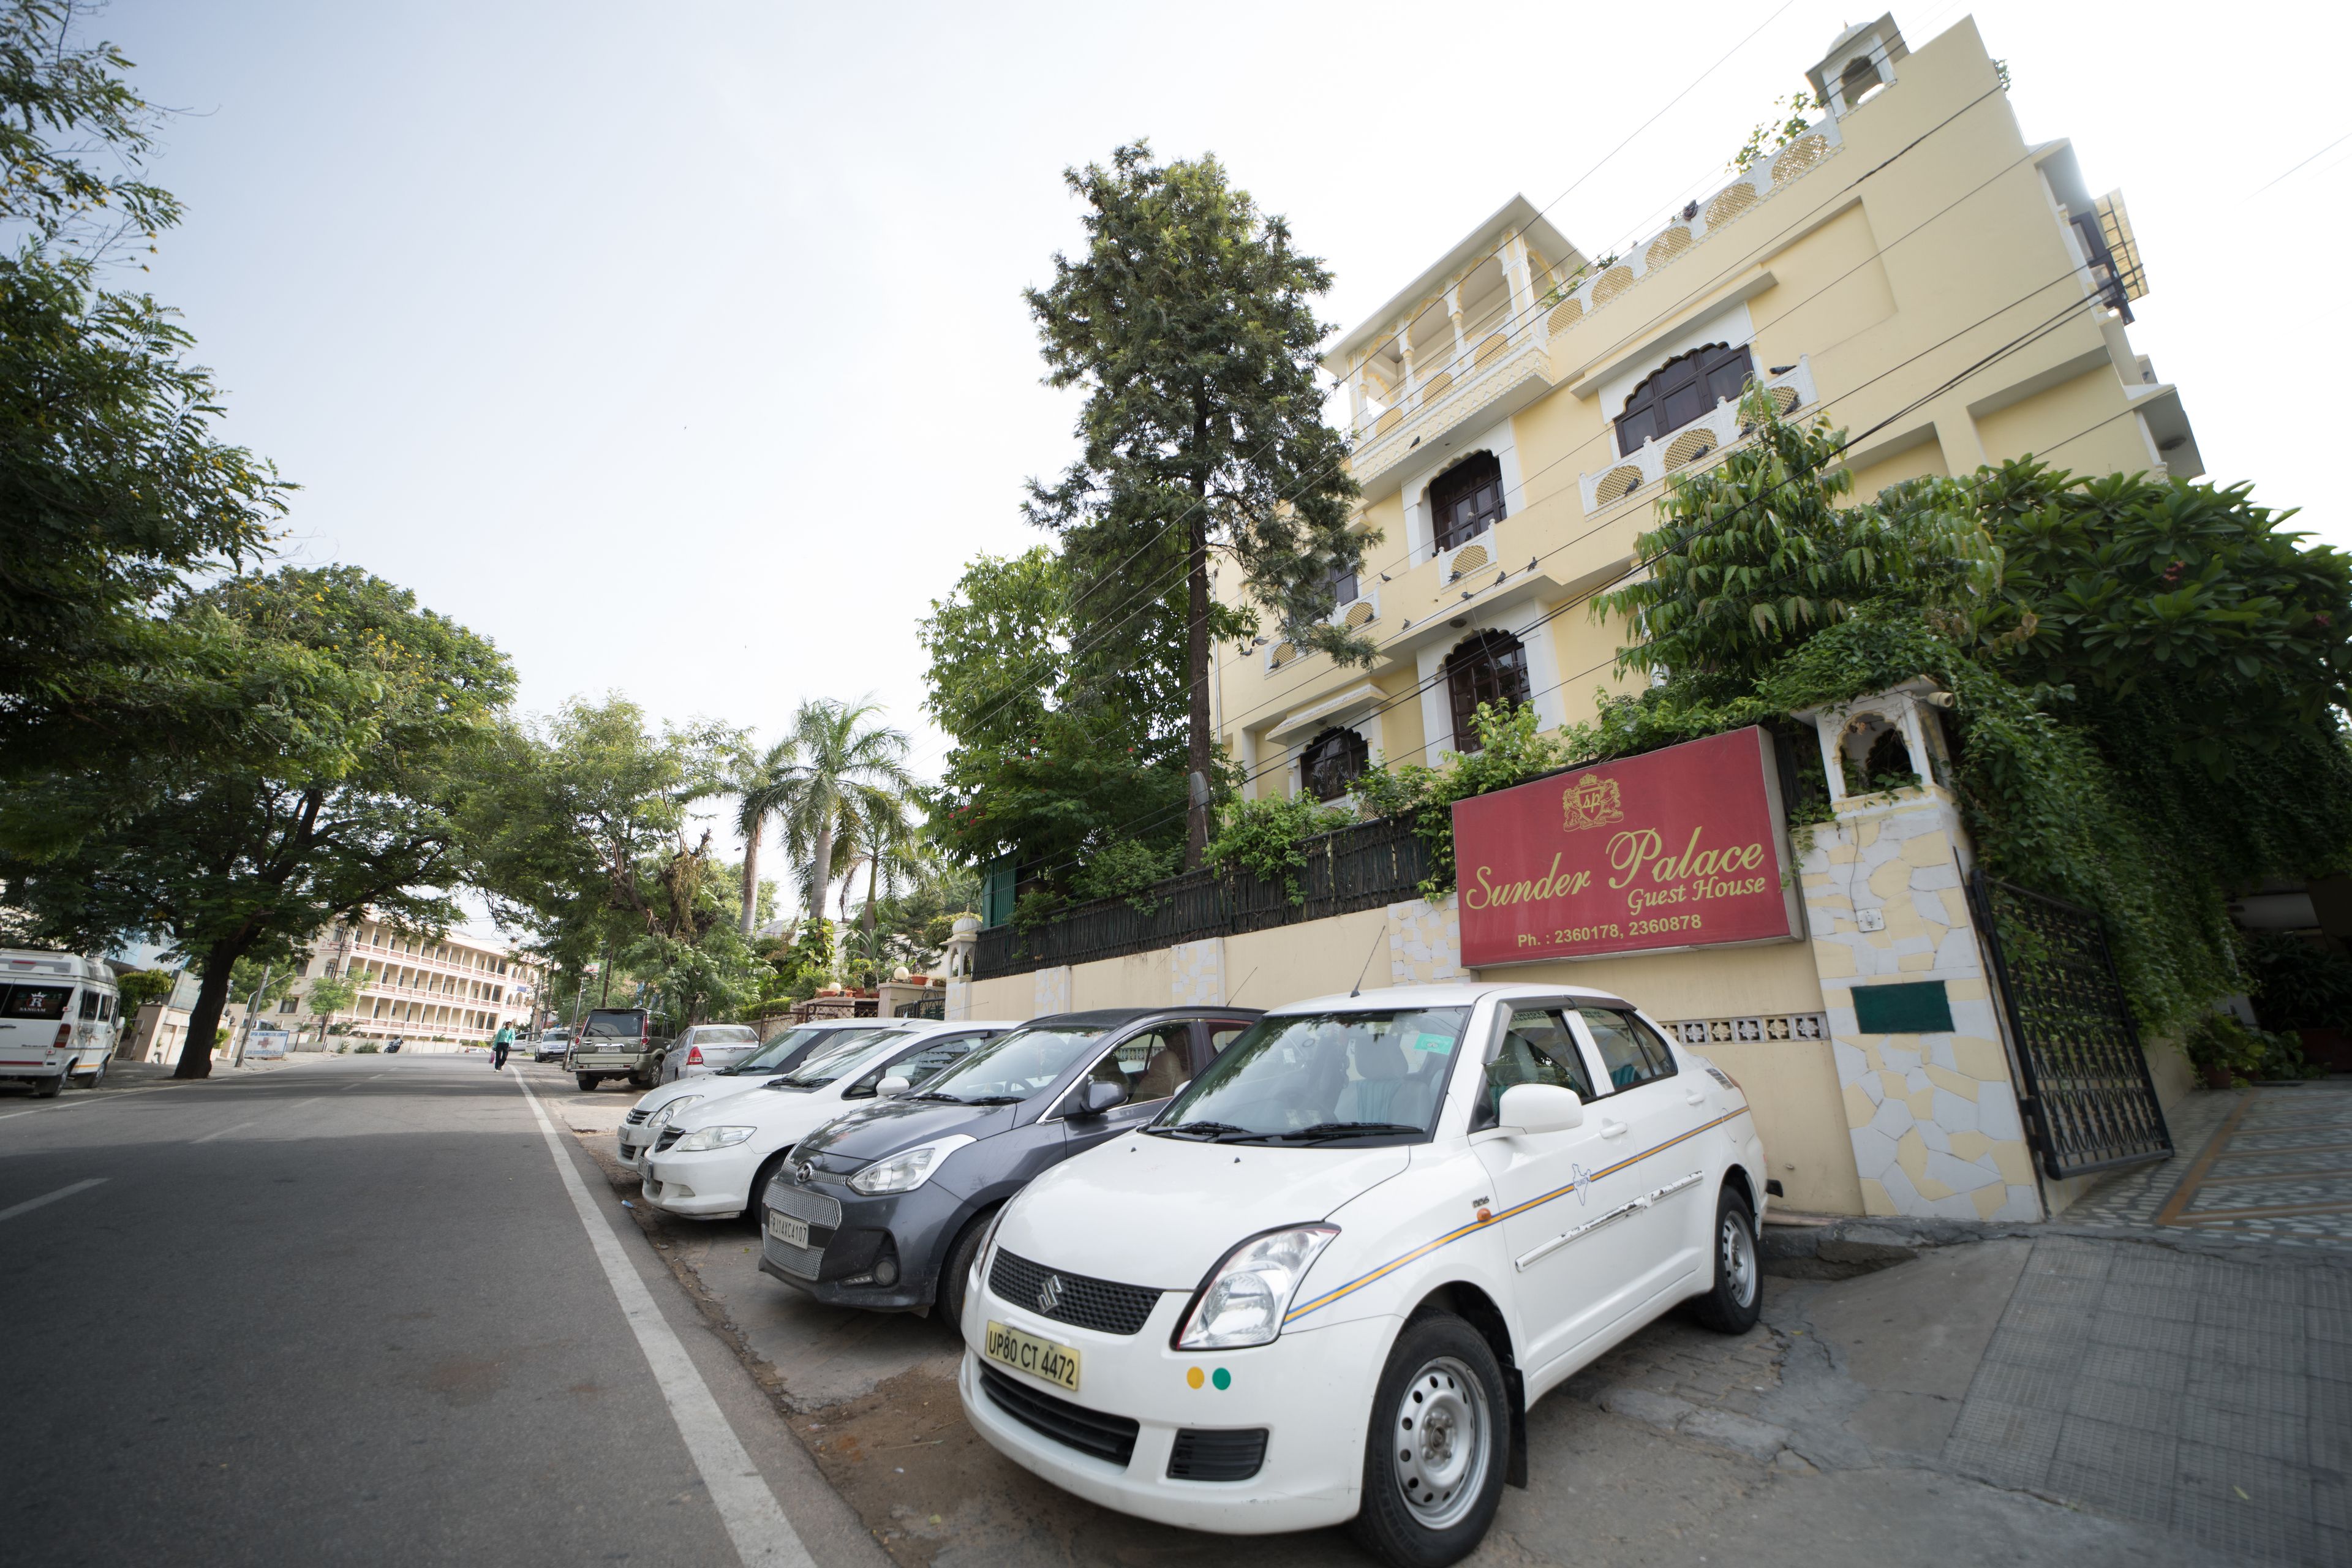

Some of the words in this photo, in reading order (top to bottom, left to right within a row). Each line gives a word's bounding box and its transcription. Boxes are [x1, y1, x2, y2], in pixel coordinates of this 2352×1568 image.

[1466, 852, 1591, 910] Sunder
[1605, 826, 1765, 889] Palace
[1627, 884, 1687, 916] Guest
[1692, 876, 1766, 901] House
[1555, 924, 1624, 943] 2360178,
[1629, 914, 1702, 936] 2360878
[772, 1216, 807, 1243] RJ14XC4107
[989, 1330, 1017, 1363] UP80
[1021, 1343, 1038, 1370] CT
[1041, 1351, 1075, 1385] 4472
